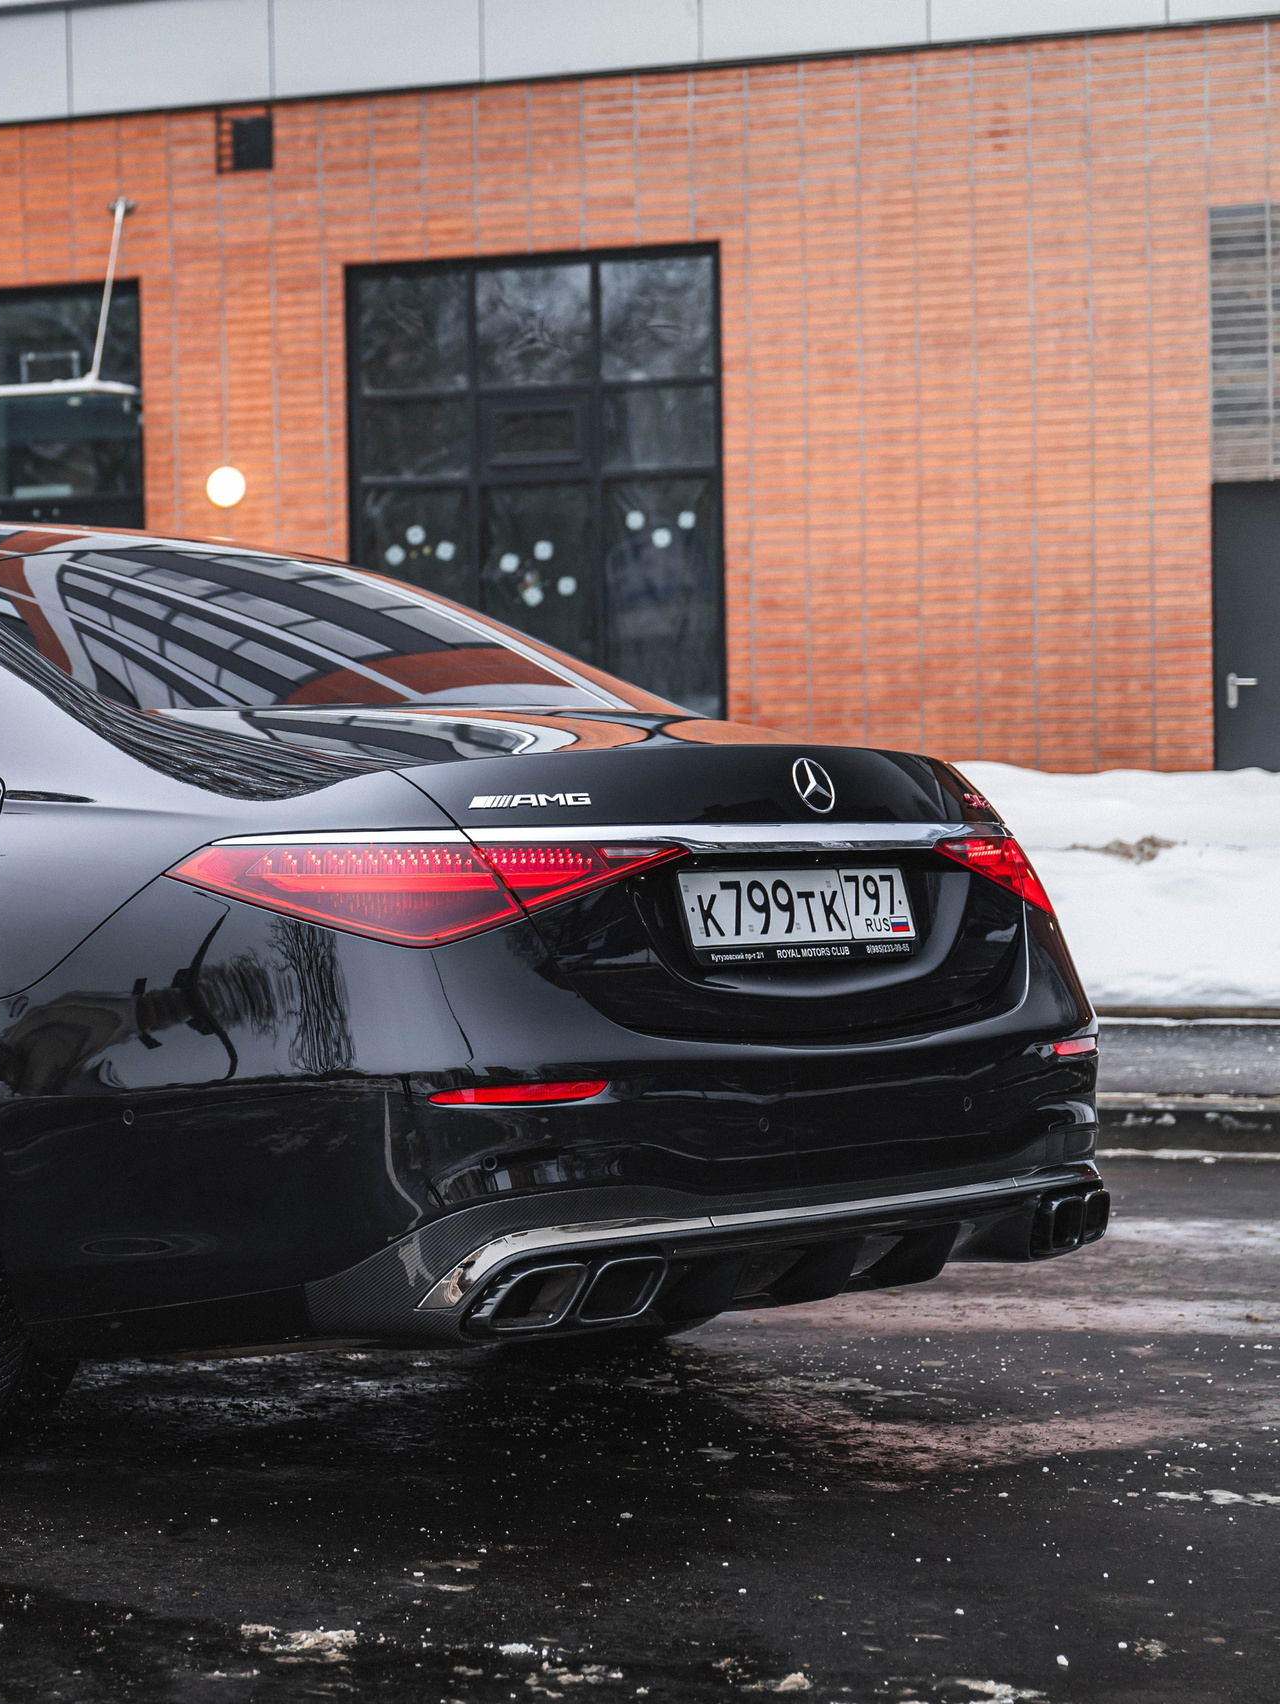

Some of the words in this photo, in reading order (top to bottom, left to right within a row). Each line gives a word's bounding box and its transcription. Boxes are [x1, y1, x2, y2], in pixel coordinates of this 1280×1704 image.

[509, 793, 592, 808] AMG
[844, 875, 894, 916] 797
[865, 917, 890, 933] RUS
[776, 948, 800, 959] ROYAL
[801, 947, 831, 958] MOTORS
[831, 946, 850, 956] CLUB
